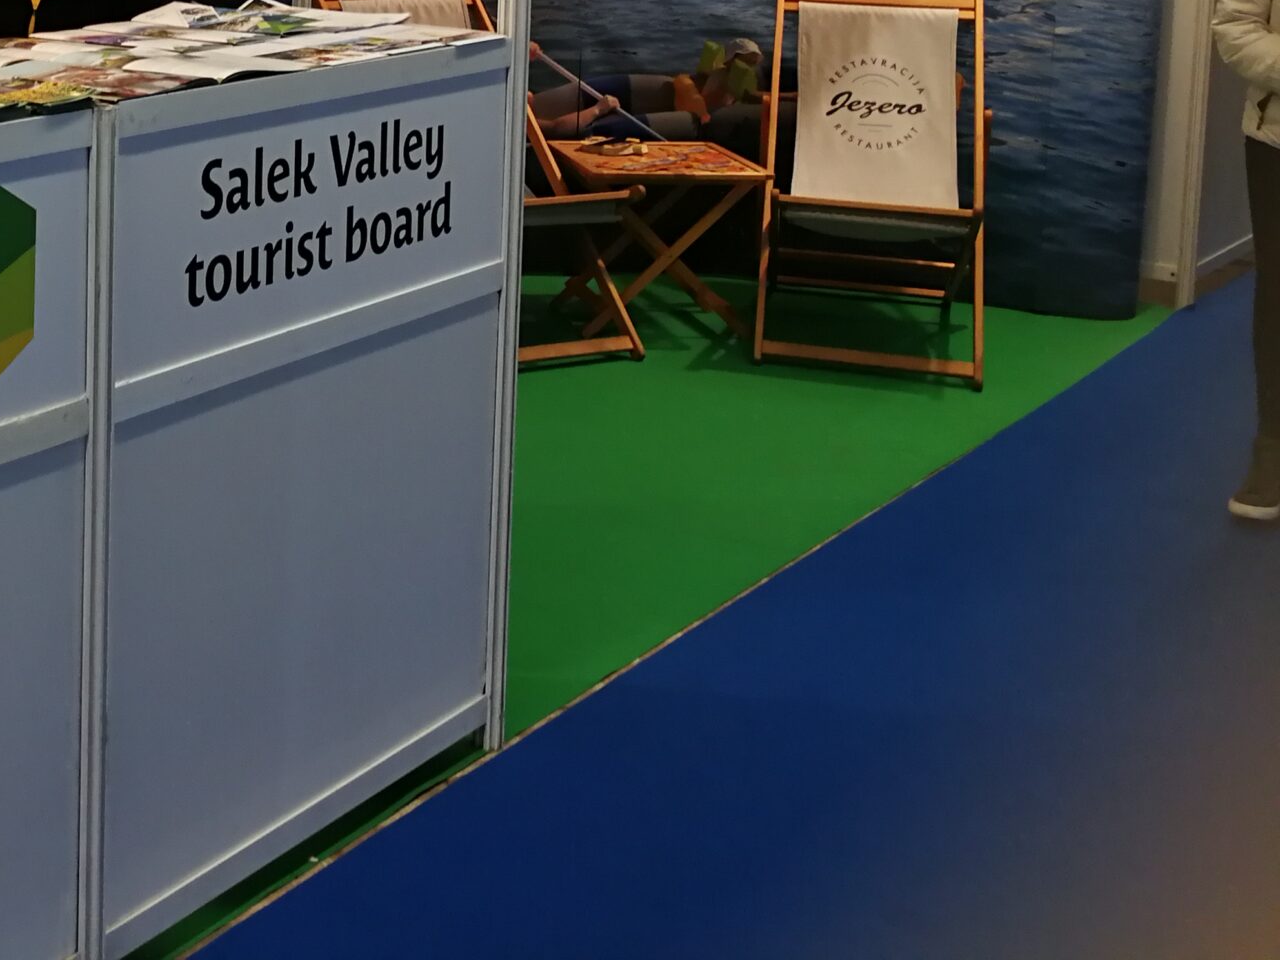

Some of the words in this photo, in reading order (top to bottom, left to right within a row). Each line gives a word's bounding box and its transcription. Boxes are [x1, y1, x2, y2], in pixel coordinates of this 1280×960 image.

[829, 58, 925, 95] RESTAVRACIJA
[826, 90, 926, 119] Jezero
[833, 123, 919, 150] RESTAURANT
[200, 138, 318, 220] Salek
[329, 118, 444, 187] Valley
[185, 220, 333, 308] tourist
[345, 180, 452, 263] board
